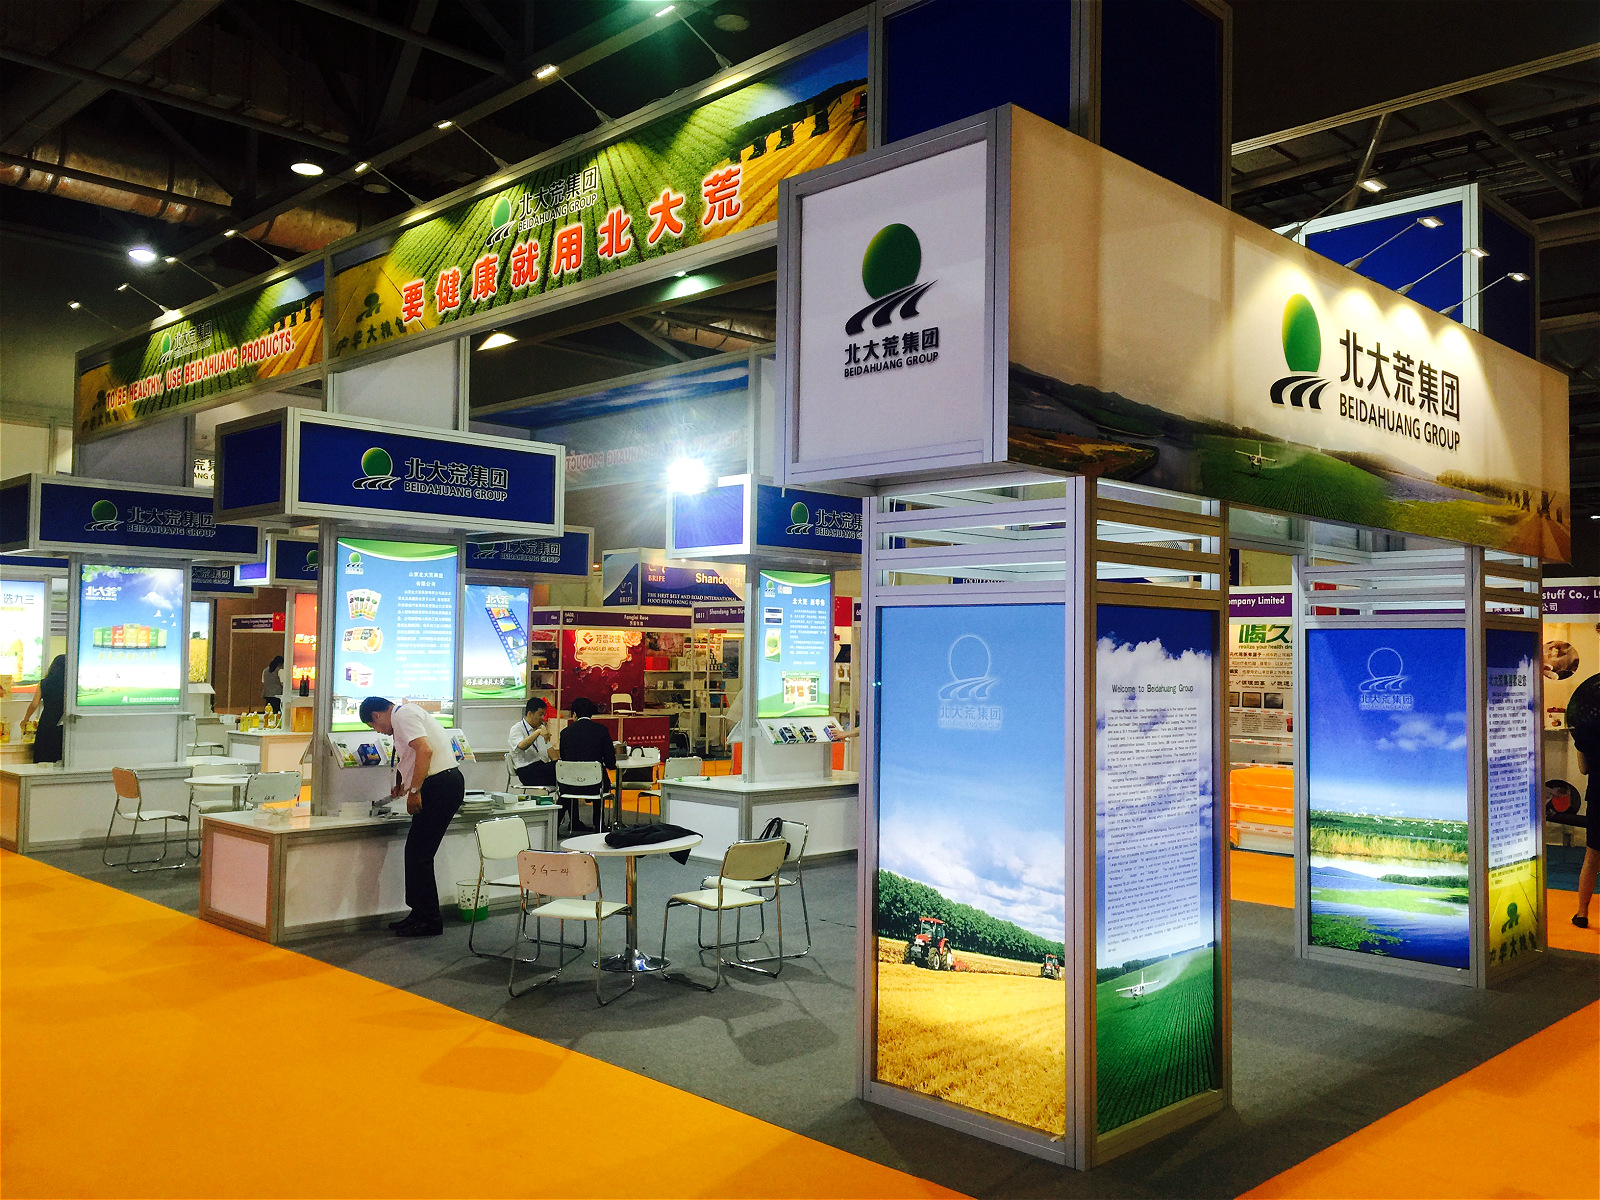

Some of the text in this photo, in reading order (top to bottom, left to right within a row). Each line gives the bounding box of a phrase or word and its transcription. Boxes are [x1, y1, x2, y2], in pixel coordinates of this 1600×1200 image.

[518, 166, 599, 220] 北大荒集团
[518, 193, 597, 231] BEIDAHUANG GROUP
[401, 164, 742, 323] 要健康就用北大荒
[844, 327, 939, 366] 北大荒集团
[106, 391, 116, 410] TO
[117, 387, 127, 405] BE
[166, 366, 181, 390] USE
[184, 348, 238, 384] BEIDAHUANG
[241, 330, 295, 366] PRODUCTS.
[844, 352, 939, 378] BEIDAHUANG GROUP
[1339, 329, 1460, 422] 北大荒集团
[1340, 393, 1460, 451] BEIDAHUANG GROUP
[404, 458, 509, 490] 北大荒集团
[404, 482, 508, 501] BEIDAHUANG GROUP
[127, 506, 216, 528] 北大荒集团
[127, 524, 216, 538] BEIDAHUANG GROUP
[815, 527, 855, 540] BEIDAHUANG
[1258, 596, 1285, 605] Limited
[1568, 590, 1589, 600] Co.,
[1112, 684, 1136, 693] Welcome
[1147, 684, 1176, 694] Beidahuang
[1178, 684, 1194, 693] Group
[1360, 694, 1413, 704] 北大荒集团
[940, 706, 1001, 721] 北大荒集团
